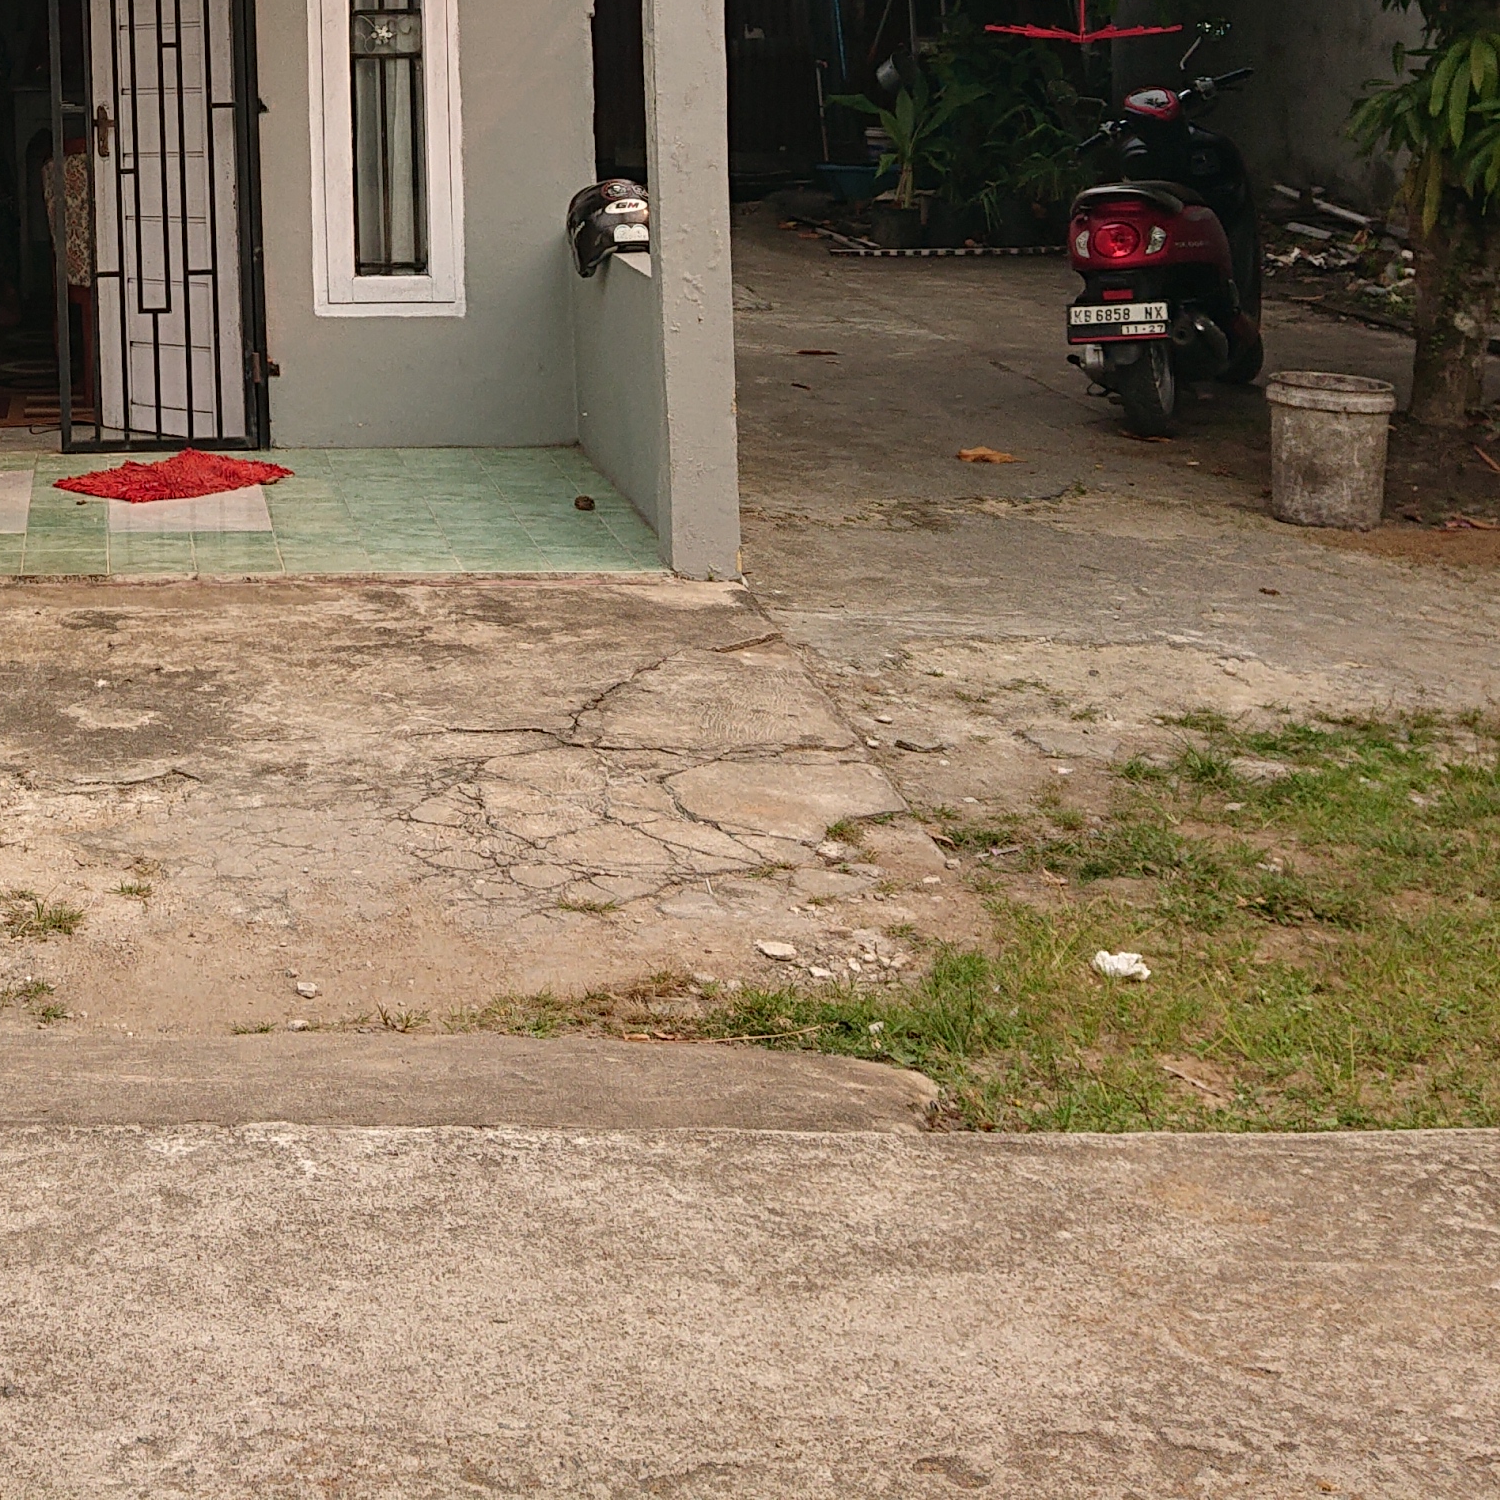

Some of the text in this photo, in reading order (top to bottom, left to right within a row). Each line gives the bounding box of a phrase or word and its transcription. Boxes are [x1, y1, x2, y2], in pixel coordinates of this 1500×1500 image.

[1074, 306, 1163, 323] KB 6858 NX
